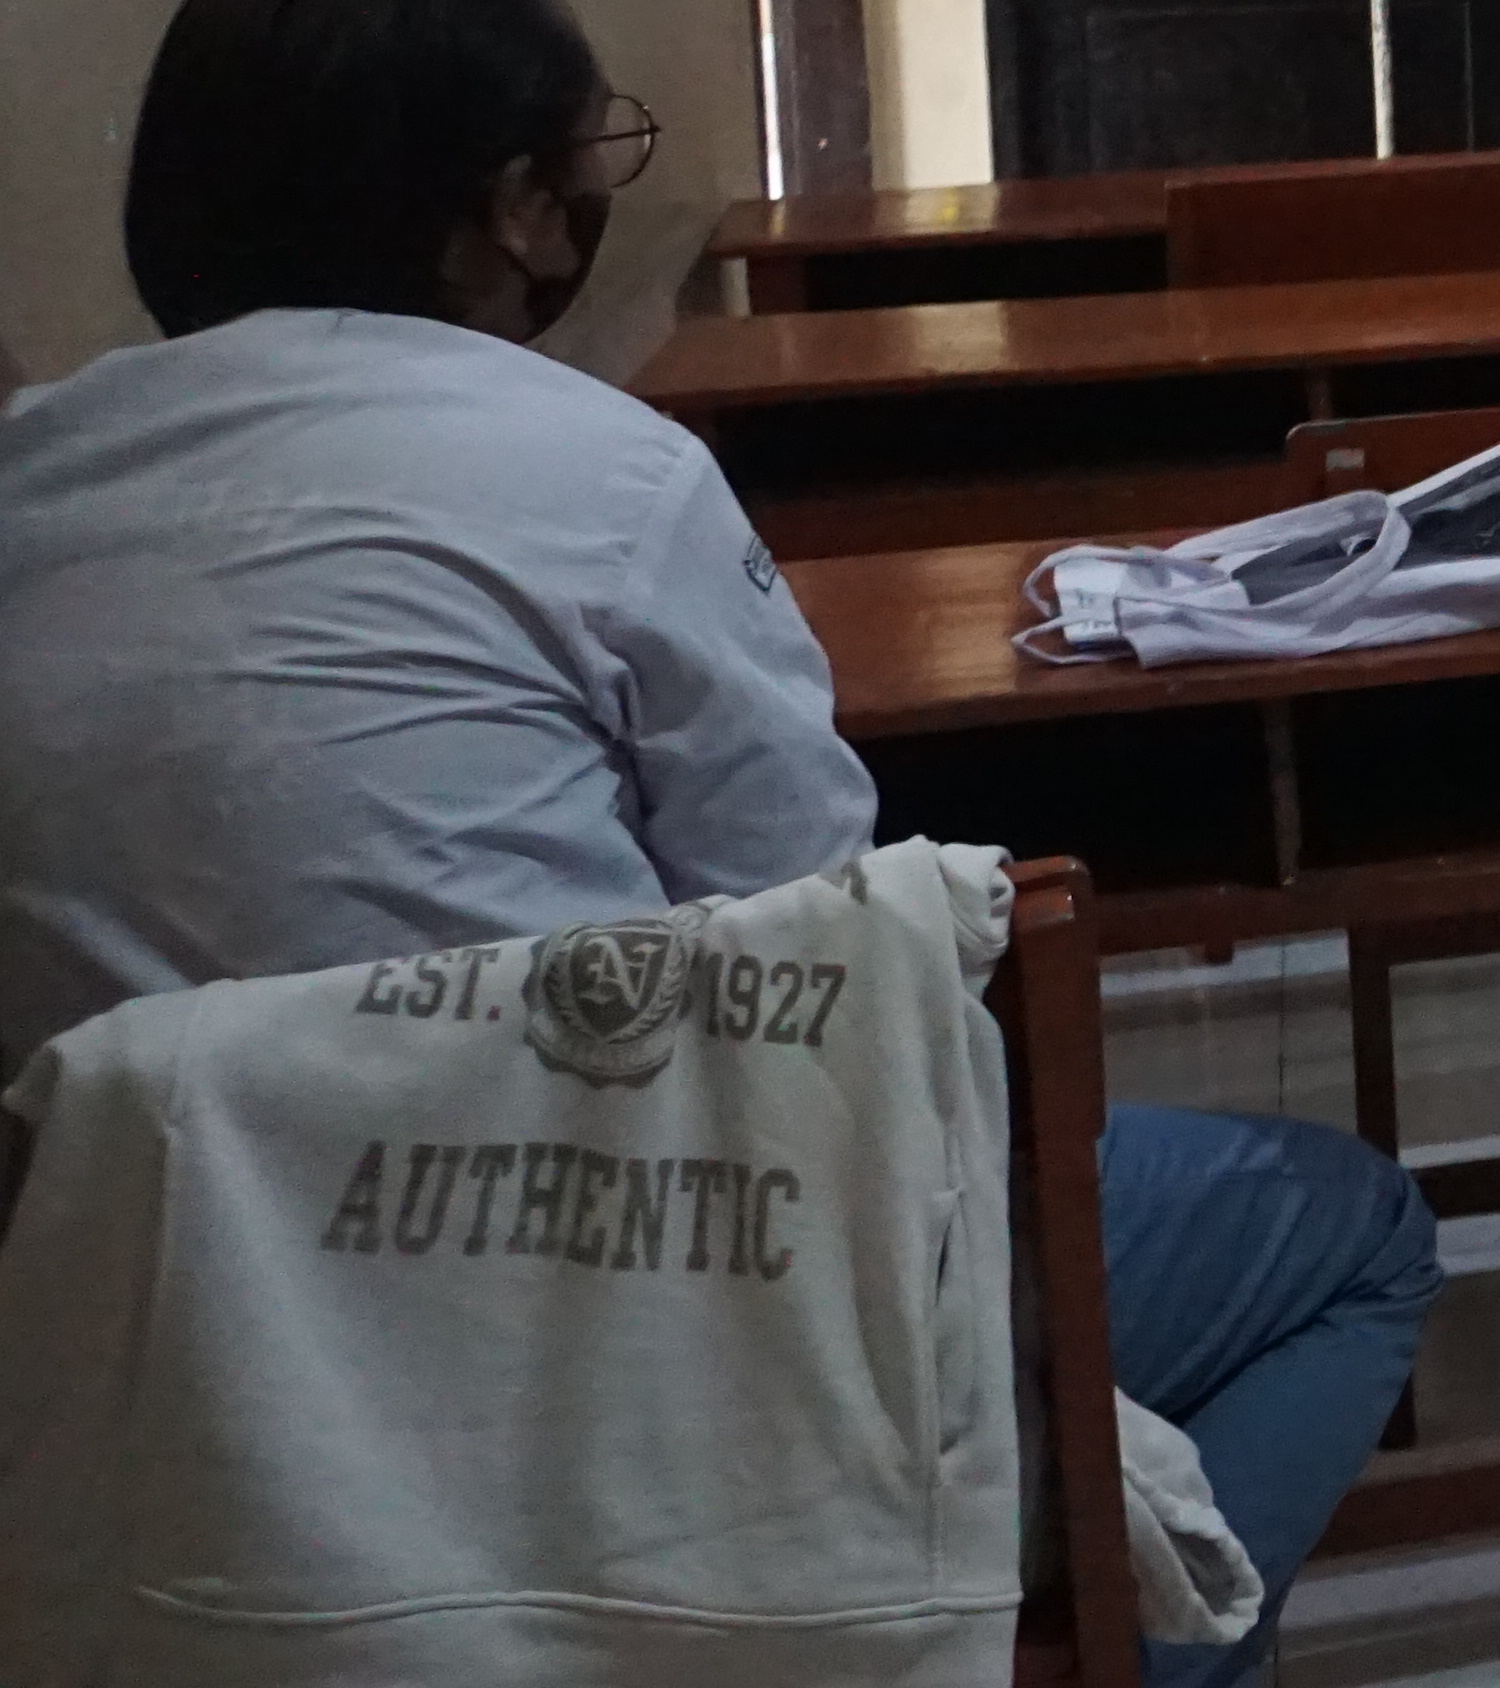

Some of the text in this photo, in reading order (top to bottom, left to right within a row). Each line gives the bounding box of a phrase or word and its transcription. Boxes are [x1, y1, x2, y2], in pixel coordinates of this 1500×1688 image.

[355, 950, 847, 1047] EST. 1927
[320, 1139, 802, 1282] AUTHENTIC
